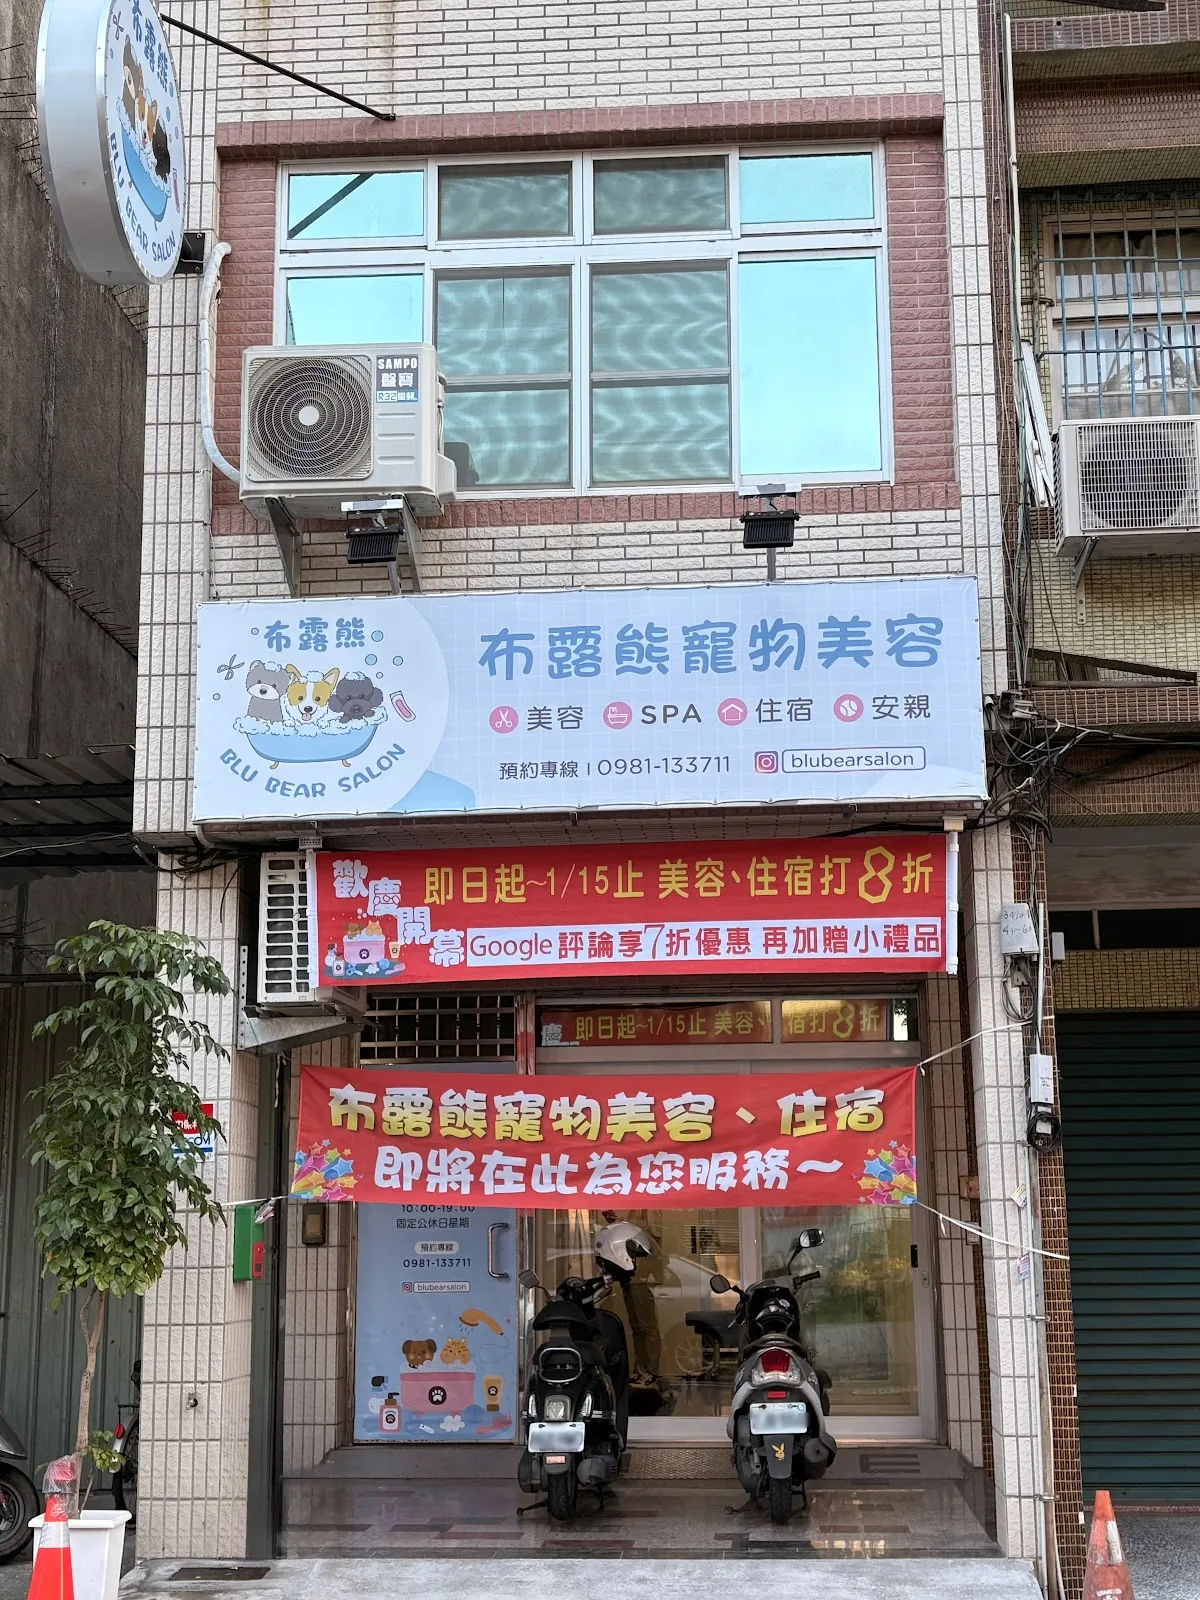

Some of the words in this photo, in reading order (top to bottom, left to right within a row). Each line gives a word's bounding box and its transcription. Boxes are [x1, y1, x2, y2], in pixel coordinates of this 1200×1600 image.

[110, 132, 125, 189] BLU
[125, 196, 149, 254] BEAR
[152, 231, 175, 262] SALON
[377, 357, 418, 370] SAMPO
[378, 392, 397, 401] R32
[263, 616, 367, 653] 布露熊
[477, 612, 944, 681] 布露熊寵物美容
[526, 705, 584, 732] 美容
[640, 703, 702, 725] SPA
[755, 697, 814, 724] 住宿
[871, 694, 931, 720] 安親
[219, 747, 258, 783] BLU
[264, 777, 327, 799] BEAR
[338, 743, 407, 793] SALON
[499, 760, 579, 780] 預約專線
[597, 755, 730, 776] 0981-133711
[790, 750, 915, 770] blubearsalon
[469, 935, 553, 961] Google
[762, 922, 940, 955] 再加贈小禮品
[396, 1217, 470, 1229] 固定公休日星期
[402, 1258, 471, 1268] 0981-133711
[417, 1283, 467, 1292] blubearsalon
